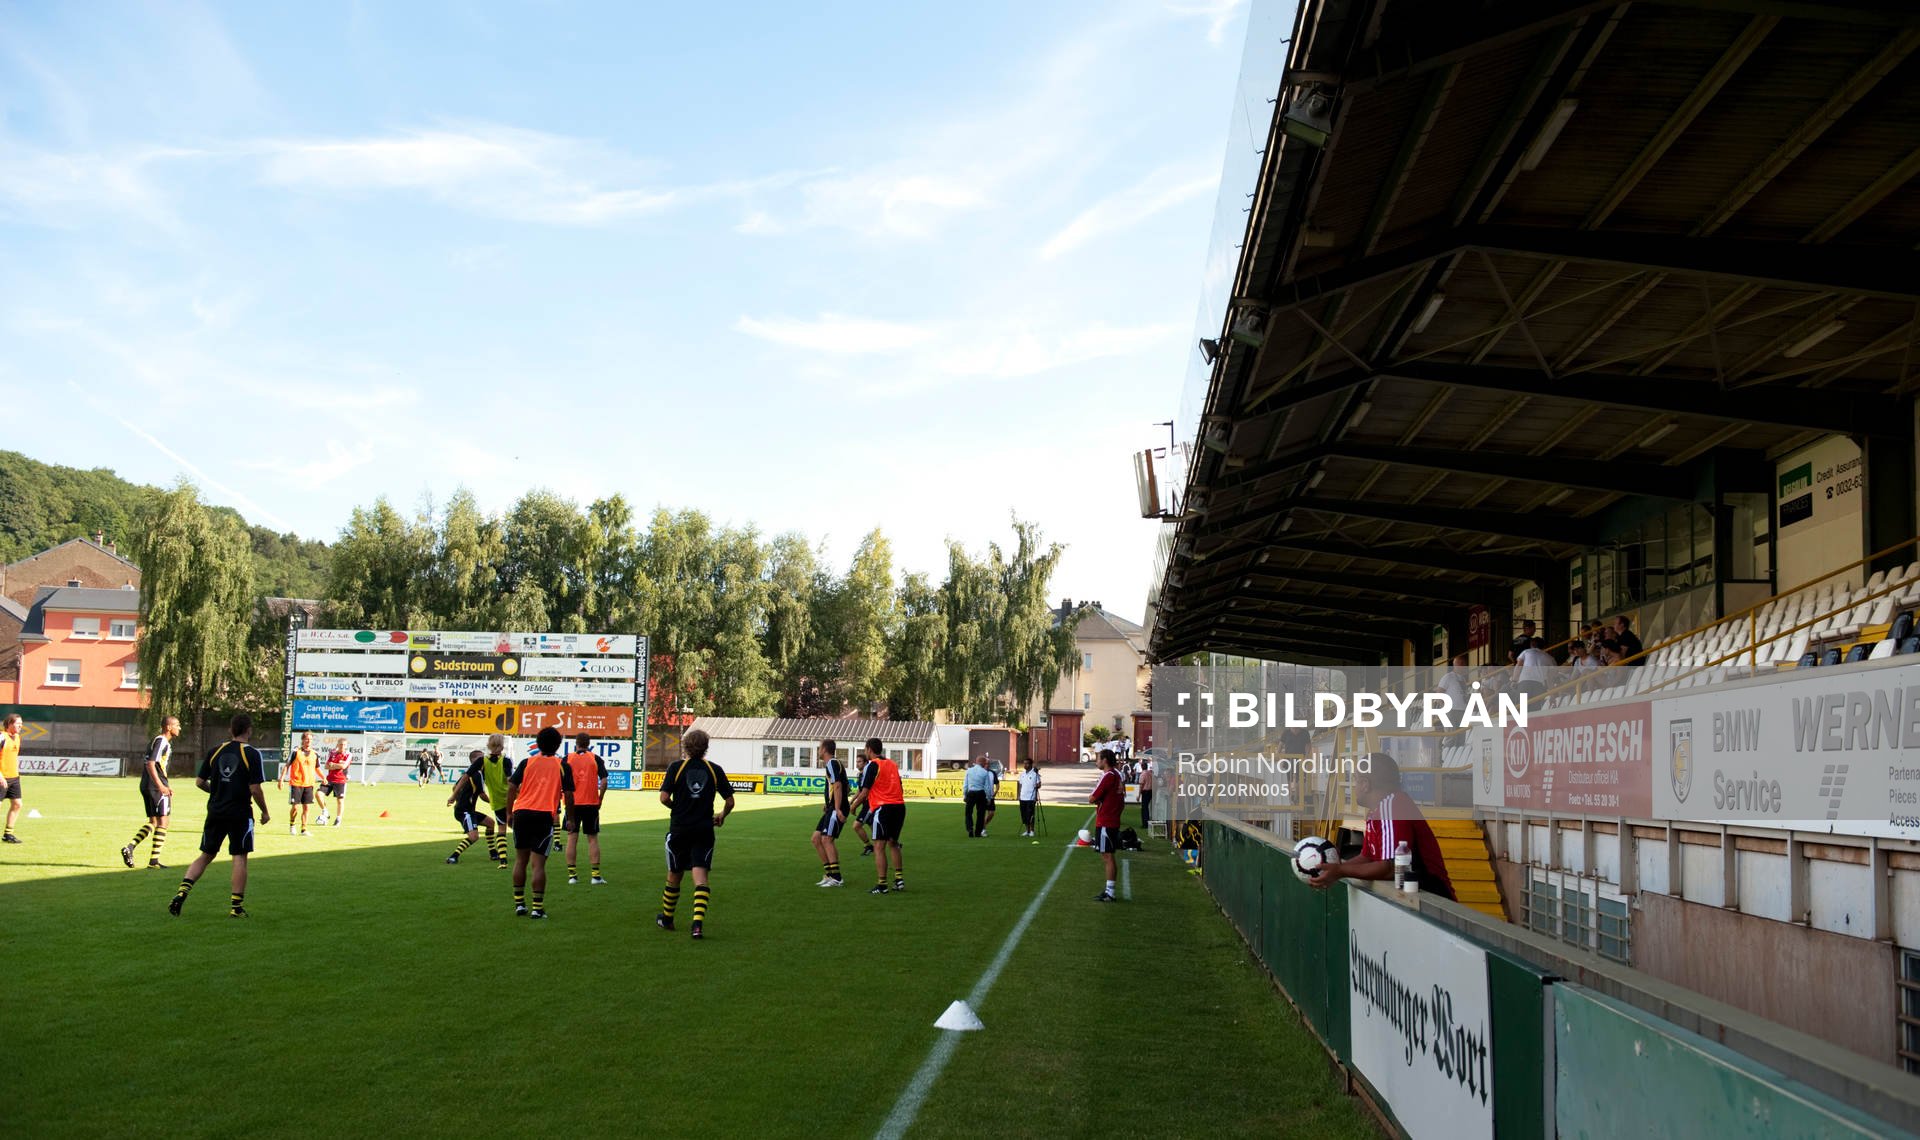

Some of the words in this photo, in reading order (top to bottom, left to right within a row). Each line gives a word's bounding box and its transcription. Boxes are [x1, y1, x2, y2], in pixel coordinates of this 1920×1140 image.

[434, 660, 495, 671] Sudstroum
[591, 665, 624, 673] CLOOS
[524, 684, 553, 692] DEMAG
[433, 706, 492, 719] danesi
[1713, 708, 1761, 752] BMW
[634, 708, 644, 770] sales-lentz.lu
[1510, 739, 1527, 765] KIA
[1533, 725, 1594, 764] WERNER
[1595, 719, 1644, 762] ESCH
[19, 758, 90, 772] UXBAZAR
[770, 776, 826, 787] BATIC
[1713, 769, 1781, 813] Service
[1431, 983, 1488, 1107] Wort
